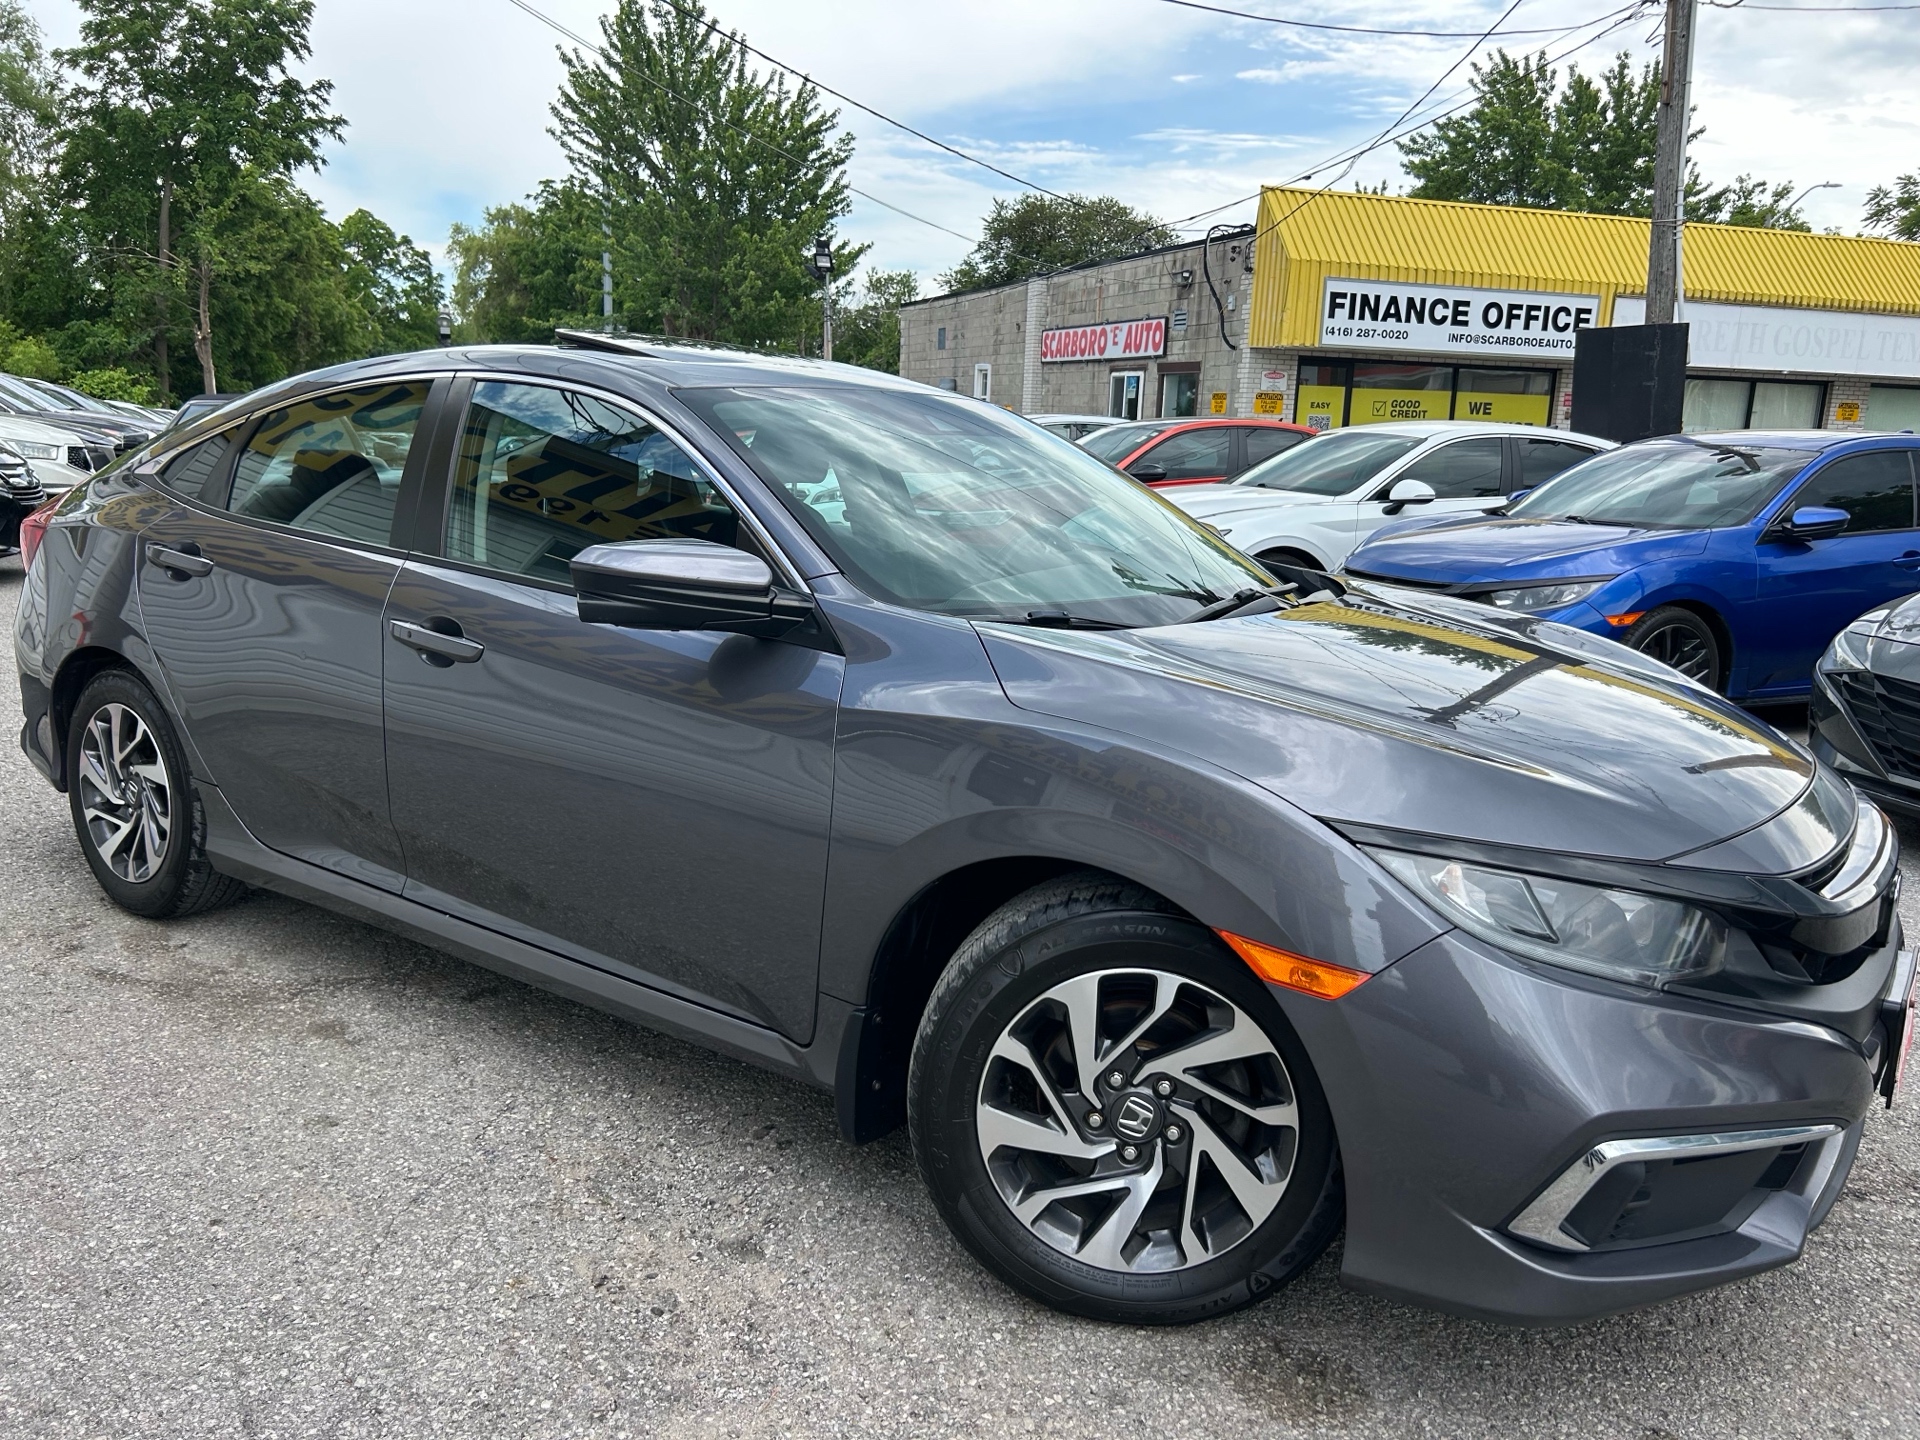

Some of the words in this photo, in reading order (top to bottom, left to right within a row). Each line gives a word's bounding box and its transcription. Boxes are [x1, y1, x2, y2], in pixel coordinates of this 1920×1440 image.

[1327, 291, 1472, 328] FINANCE
[1481, 301, 1593, 333] OFFICE
[1041, 327, 1108, 359] SCARBORO
[1122, 320, 1163, 354] AUTO
[1325, 326, 1353, 337] (416)
[1356, 328, 1409, 340] 287-0020
[1447, 333, 1576, 349] INFO@SCARBOROEAUTO.
[1773, 324, 1871, 361] GOSPEL
[1310, 401, 1331, 410] EASY
[1391, 400, 1421, 409] GOOD
[1468, 401, 1493, 416] WE
[1390, 409, 1428, 419] CREDIT
[1038, 931, 1075, 955] ALL
[1082, 924, 1167, 938] SEASON
